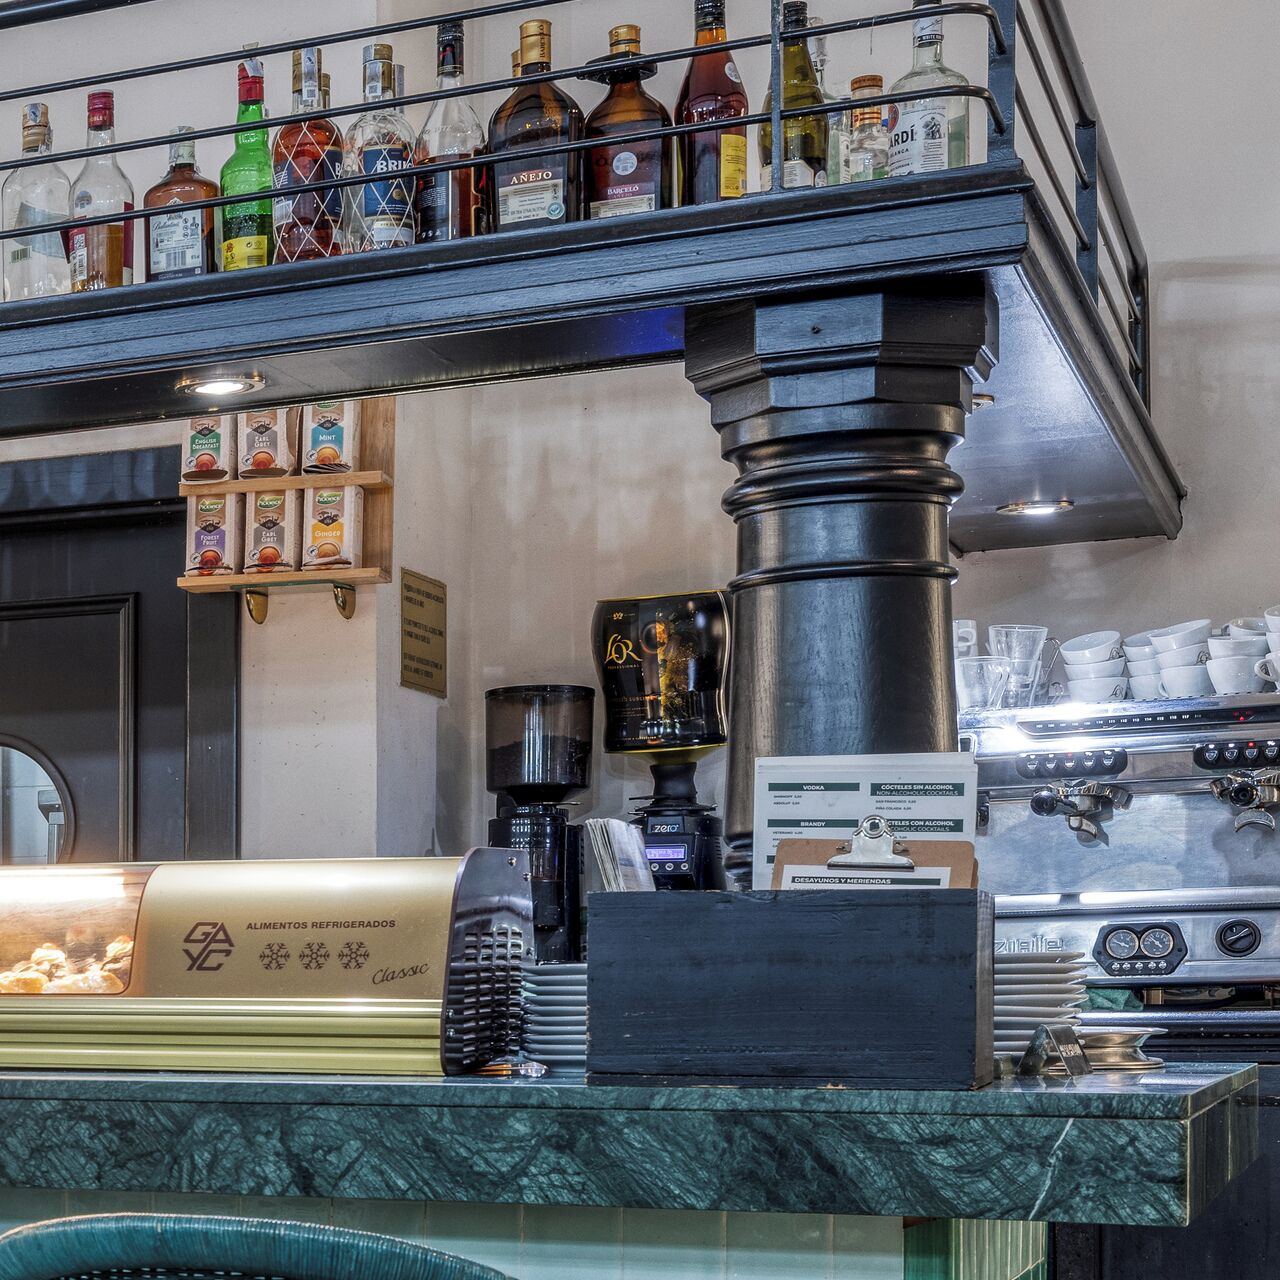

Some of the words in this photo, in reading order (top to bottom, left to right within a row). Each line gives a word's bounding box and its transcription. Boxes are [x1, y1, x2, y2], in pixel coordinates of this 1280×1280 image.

[888, 124, 915, 149] ARDÍ
[510, 170, 552, 185] AÑEJO
[607, 184, 639, 195] BARCELÓ
[881, 782, 912, 791] CÓCTELES
[654, 824, 678, 833] zero
[246, 921, 309, 931] ALIMENTOS
[311, 919, 397, 930] REFRIGERADOS
[372, 963, 429, 986] Classic
